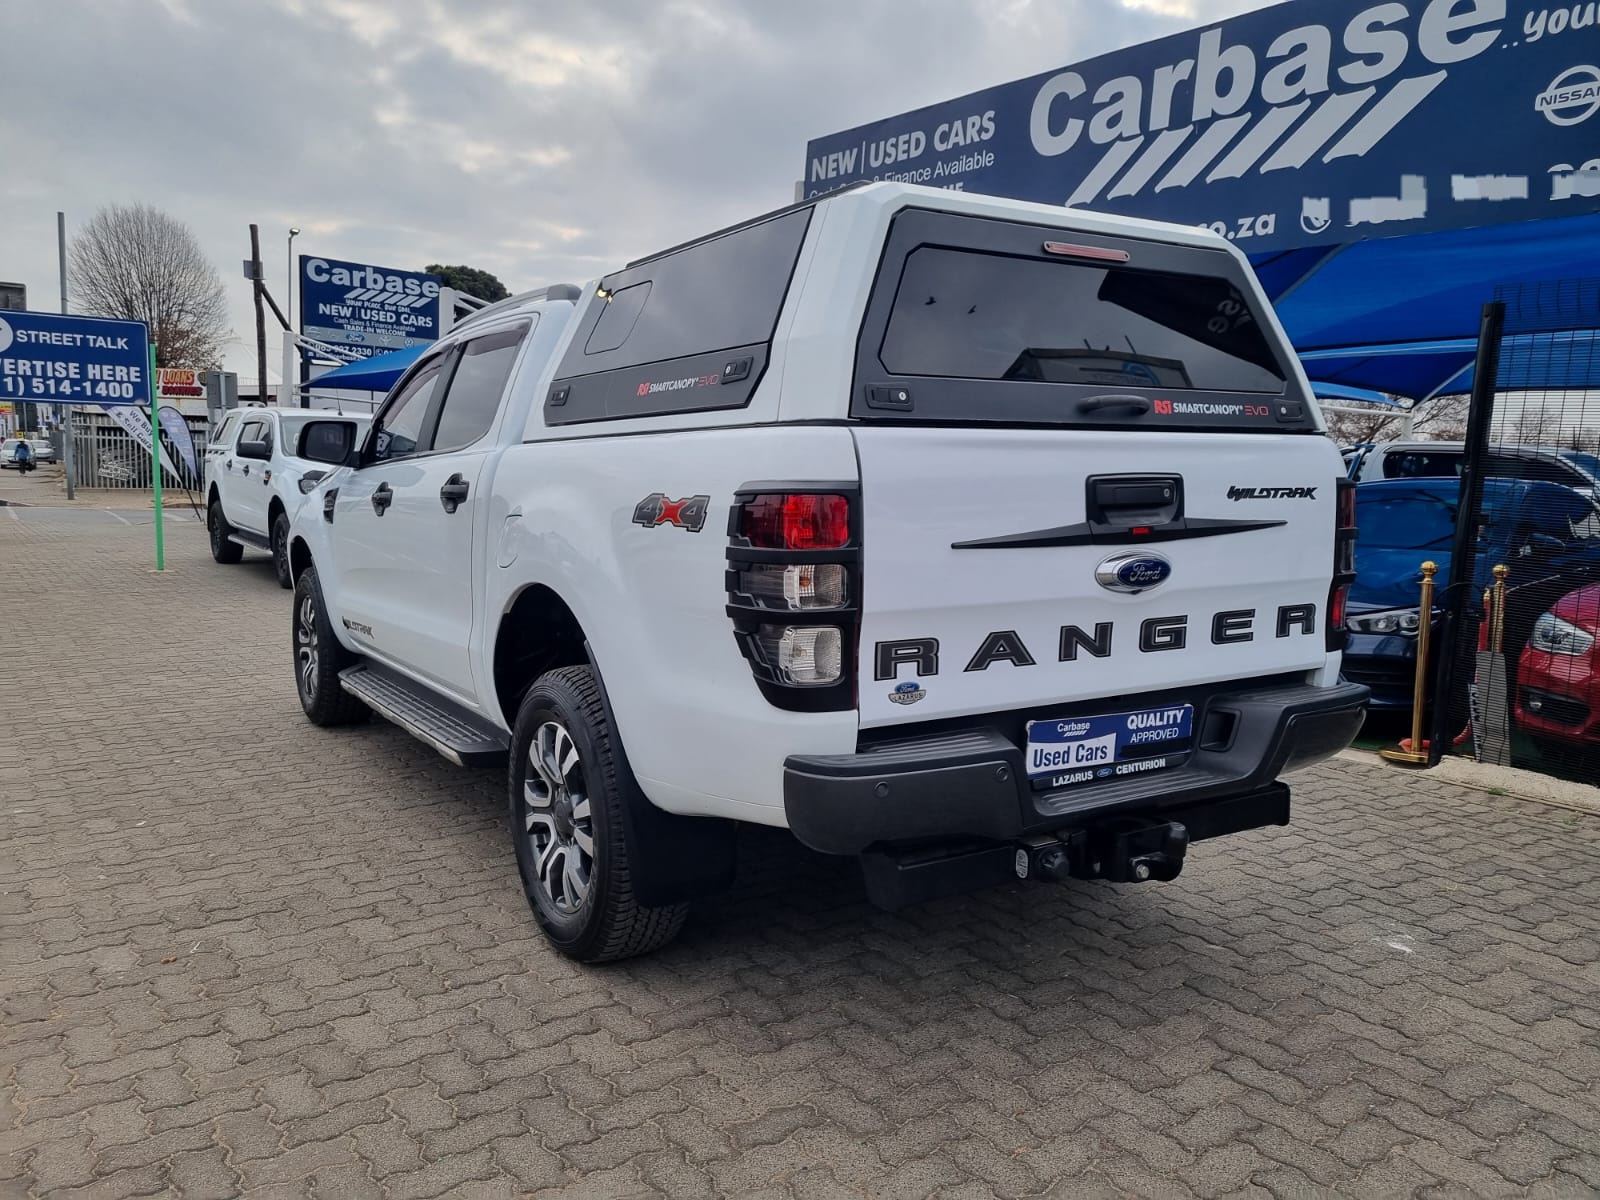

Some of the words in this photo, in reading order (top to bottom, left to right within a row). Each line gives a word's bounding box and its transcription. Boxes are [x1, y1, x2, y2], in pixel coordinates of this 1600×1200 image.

[1029, 0, 1507, 157] Carbase
[811, 148, 858, 183] NEW
[869, 131, 926, 168] USED
[933, 110, 996, 152] CARS
[933, 149, 995, 178] Available
[306, 259, 440, 298] Carbase
[318, 303, 353, 318] NEW
[361, 308, 396, 323] USED
[400, 313, 433, 328] CARS
[333, 317, 349, 325] Cash
[349, 318, 365, 326] Sales
[371, 321, 392, 329] Finance
[393, 324, 416, 332] Available
[16, 329, 84, 347] STREET
[86, 335, 128, 350] TALK
[343, 324, 375, 333] TRADE-IN
[375, 328, 407, 337] WELCOME
[352, 347, 372, 356] 2330
[0, 358, 81, 379] ERTISE
[87, 364, 141, 382] HERE
[162, 370, 195, 385] LOANS
[32, 378, 134, 398] 514-1400
[129, 410, 141, 423] We
[1244, 405, 1269, 417] EVO
[136, 432, 153, 449] Cars
[1226, 485, 1318, 502] WILDTRAK
[1129, 561, 1163, 582] Ford
[873, 603, 1318, 682] RANGER
[1057, 721, 1091, 733] Carbase
[1127, 709, 1185, 730] QUALITY
[1130, 728, 1179, 744] APPROVED
[1033, 746, 1071, 768] Used
[1075, 743, 1108, 763] Cars
[1052, 771, 1094, 787] LAZARUS
[1116, 758, 1166, 775] CENTURION
